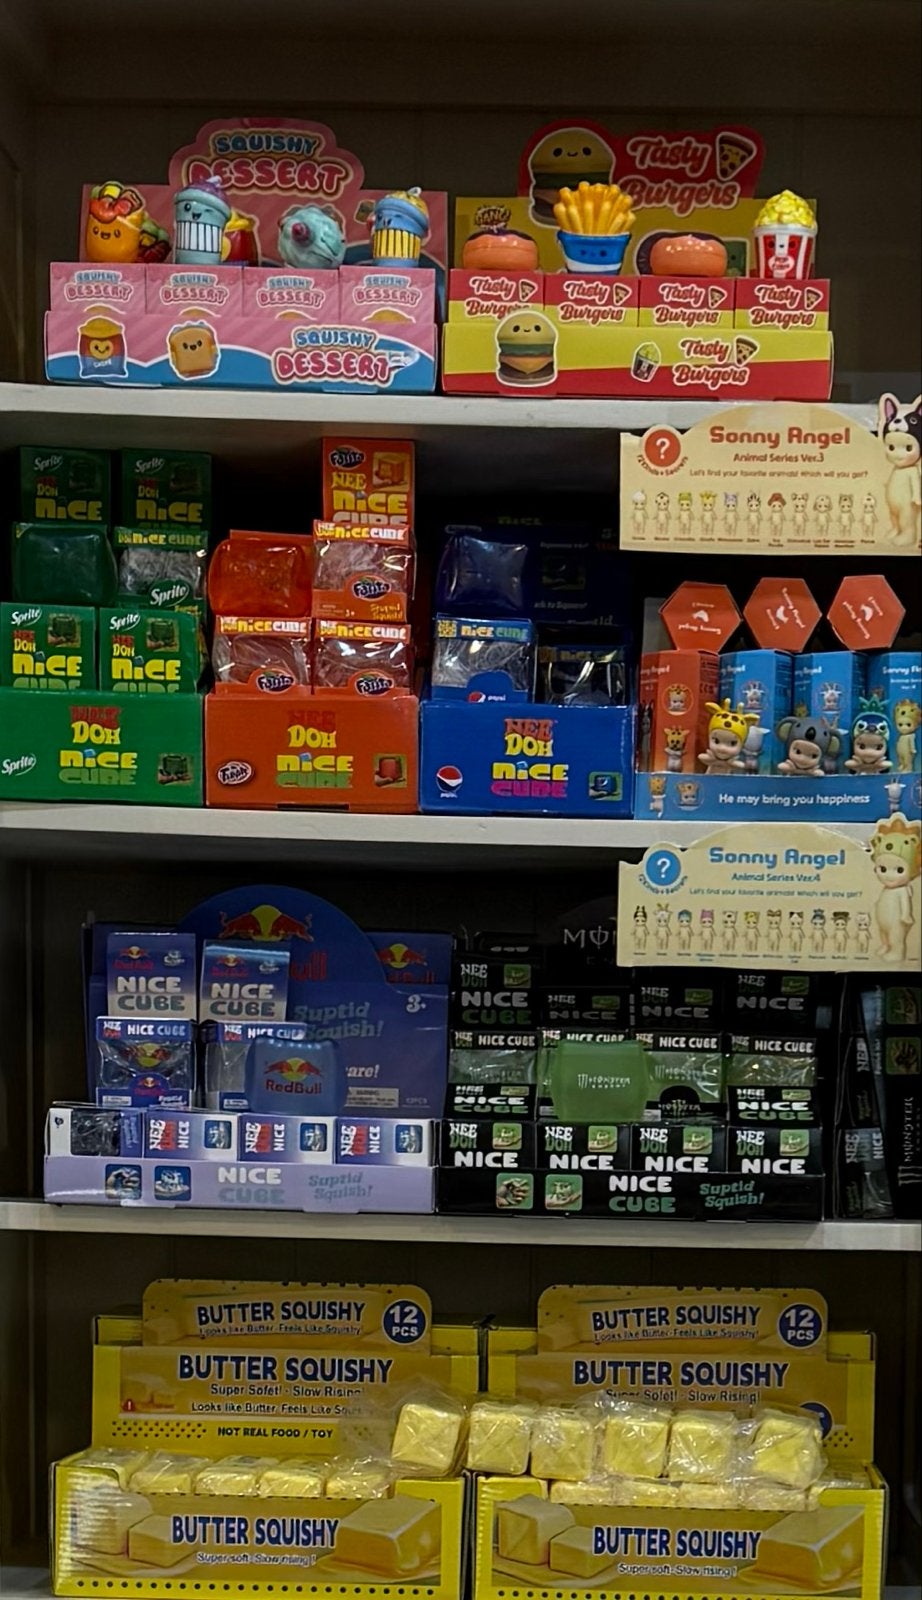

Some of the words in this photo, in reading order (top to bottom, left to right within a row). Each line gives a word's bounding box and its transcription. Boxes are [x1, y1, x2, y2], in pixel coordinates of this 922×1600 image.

[215, 135, 318, 155] SQUISHY
[627, 137, 711, 177] Tasty
[189, 160, 346, 191] DESSERT
[621, 177, 739, 215] Burgers
[77, 272, 120, 284] SQUISHY
[172, 274, 215, 286] SQUISHY
[268, 277, 310, 289] SQUISHY
[365, 275, 410, 288] SQUISHY
[66, 284, 131, 301] DESSERT
[162, 286, 226, 303] DESSERT
[355, 287, 420, 304] DESSERT
[469, 276, 515, 299] Tasty
[564, 281, 610, 304] Tasty
[659, 282, 705, 305] Tasty
[755, 284, 800, 307] Tasty
[258, 288, 324, 306] DESSERT
[559, 302, 625, 326] Burgers
[654, 306, 720, 328] Burgers
[751, 307, 815, 329] Burgers
[294, 327, 376, 348] SQUISHY
[681, 338, 730, 365] Tasty
[275, 352, 392, 381] DESSERT
[673, 365, 750, 391] Burgers
[710, 426, 780, 448] Sonny
[787, 428, 850, 448] Angel
[733, 454, 768, 463] Animal
[769, 454, 799, 463] Series
[800, 454, 824, 463] Ver.3
[332, 472, 366, 489] NEE
[150, 584, 190, 606] Sprite
[11, 607, 43, 627] Sprite
[109, 612, 141, 632] Sprite
[71, 721, 121, 745] DOH
[287, 725, 336, 749] DOH
[505, 733, 554, 757] DOH
[1, 753, 37, 776] Sprite
[490, 780, 569, 798] CUBE
[719, 793, 734, 803] He
[736, 794, 760, 806] may
[762, 793, 790, 807] bring
[792, 796, 814, 807] you
[816, 793, 870, 807] happiness
[710, 847, 778, 870] Sonny
[784, 849, 845, 870] Angel
[460, 964, 488, 979] NEE
[116, 976, 182, 993] NICE
[211, 983, 275, 999] NICE
[117, 996, 185, 1012] CUBE
[461, 992, 529, 1008] NICE
[736, 997, 805, 1011] NICE
[209, 1002, 276, 1017] CUBE
[294, 1003, 370, 1022] Suptid
[461, 1009, 532, 1025] CUBE
[549, 1010, 617, 1020] NICE
[641, 1005, 710, 1019] NICE
[127, 1024, 154, 1036] NICE
[157, 1025, 186, 1036] CUBE
[478, 1034, 505, 1047] NICE
[507, 1035, 535, 1047] CUBE
[659, 1036, 686, 1049] NICE
[688, 1037, 718, 1049] CUBE
[754, 1039, 782, 1052] NICE
[784, 1040, 814, 1053] CUBE
[265, 1079, 322, 1095] RedBull
[454, 1096, 525, 1105] NICE
[737, 1101, 809, 1111] NICE
[453, 1105, 529, 1114] CUBE
[739, 1111, 814, 1121] CUBE
[177, 1120, 190, 1149] NICE
[273, 1123, 285, 1151] NICE
[449, 1123, 478, 1137] NEE
[545, 1126, 573, 1141] NEE
[639, 1128, 669, 1143] NEE
[736, 1129, 766, 1144] NEE
[369, 1126, 380, 1154] NICE
[872, 1131, 884, 1160] NICE
[454, 1151, 518, 1168] NICE
[550, 1154, 614, 1170] NICE
[644, 1156, 709, 1173] NICE
[741, 1158, 806, 1175] NICE
[217, 1166, 282, 1185] NICE
[308, 1173, 363, 1187] Suptid
[609, 1175, 673, 1194] NICE
[699, 1180, 755, 1197] Suptid
[217, 1187, 285, 1204] CUBE
[314, 1186, 373, 1202] Squish!
[705, 1192, 765, 1211] Squish!
[608, 1196, 676, 1213] CUBE
[197, 1302, 274, 1326] BUTTER
[279, 1300, 365, 1322] SQUISHY
[388, 1304, 419, 1325] 12
[592, 1306, 671, 1331] BUTTER
[676, 1305, 761, 1326] SQUISHY
[783, 1309, 814, 1329] 12
[391, 1325, 419, 1338] PCS
[787, 1329, 814, 1341] PCS
[178, 1355, 277, 1381] BUTTER
[285, 1357, 393, 1383] SQUISHY
[573, 1360, 672, 1387] BUTTER
[680, 1361, 789, 1387] SQUISHY
[192, 1402, 222, 1413] Looks
[225, 1402, 242, 1413] like
[245, 1402, 276, 1414] Butter
[281, 1403, 307, 1414] Feels
[217, 1427, 240, 1436] NOT
[243, 1427, 268, 1437] REAL
[271, 1428, 300, 1438] FOOD
[303, 1428, 308, 1438] /
[312, 1429, 334, 1438] TOY
[172, 1515, 248, 1545] BUTTER
[255, 1518, 339, 1547] SQUISHY
[593, 1527, 670, 1556] BUTTER
[676, 1529, 761, 1559] SQUISHY
